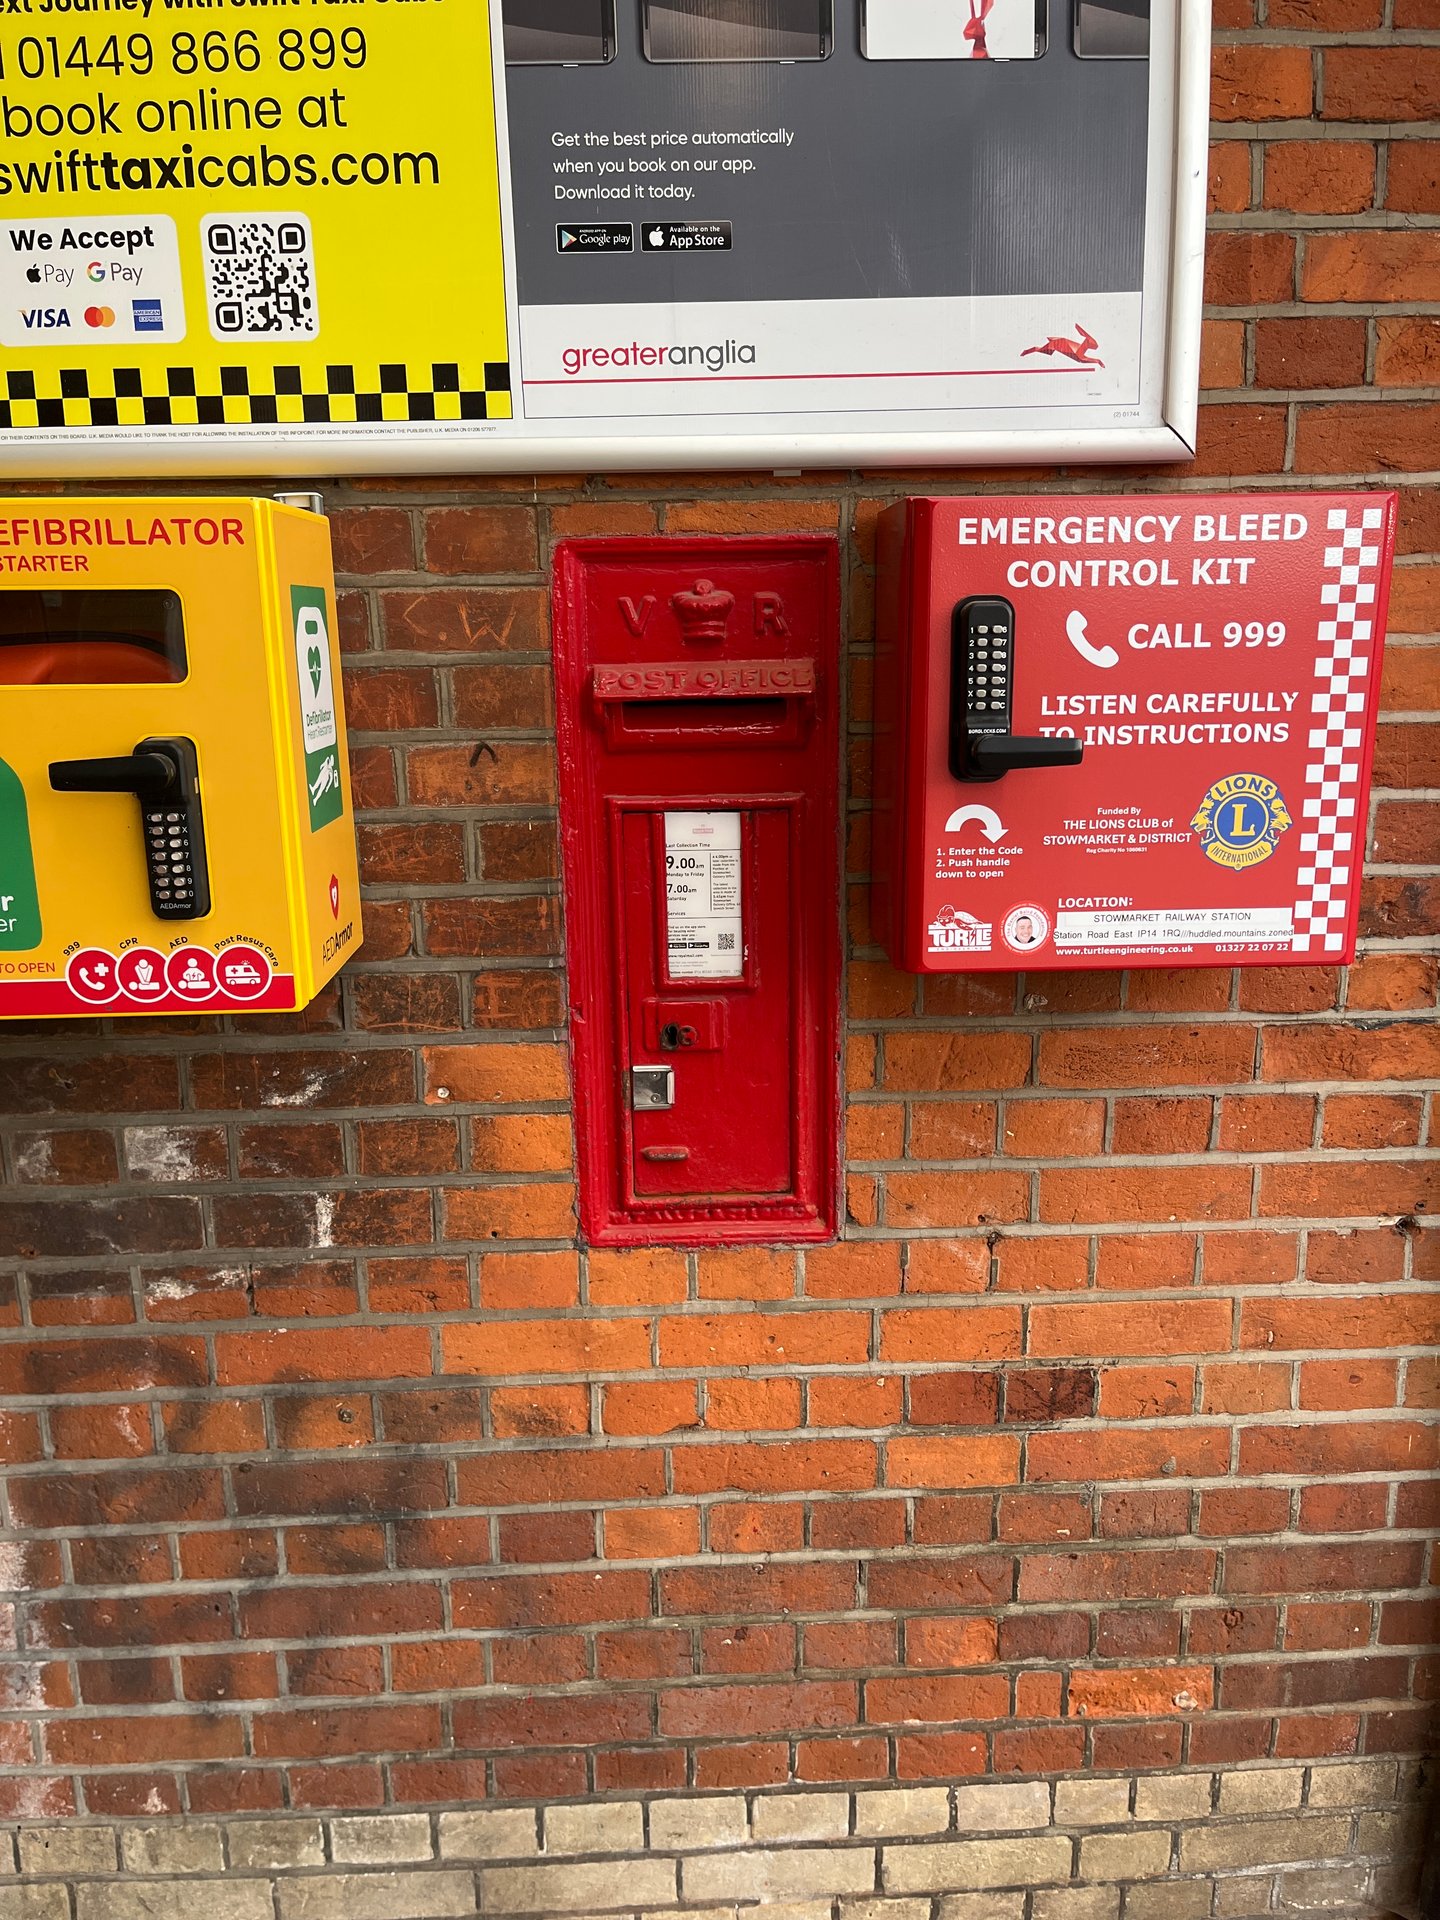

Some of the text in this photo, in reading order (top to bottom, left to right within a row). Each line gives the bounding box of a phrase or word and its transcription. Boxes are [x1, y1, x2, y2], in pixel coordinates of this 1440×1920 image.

[18, 33, 154, 78] 01449
[171, 30, 261, 75] 866
[278, 27, 367, 72] 899
[2, 88, 347, 137] book online at
[552, 128, 794, 149] Get the best price automatically
[553, 157, 756, 176] when you book on our app.
[554, 183, 695, 201] Download it today.
[9, 226, 155, 255] We Accept
[580, 233, 630, 247] Google play
[670, 235, 725, 248] App Store
[44, 264, 74, 287] Pay
[110, 263, 143, 286] Pay
[19, 309, 71, 328] VISA
[562, 340, 756, 375] greateranglia
[958, 513, 1308, 545] EMERGENCY BLEED
[1007, 557, 1256, 588] CONTROL KIT
[618, 591, 791, 637] V R
[1127, 621, 1286, 649] CALL 999
[597, 668, 813, 692] POST OFFICE
[1041, 691, 1299, 716] LISTEN CAREFULLY
[1083, 722, 1290, 746] INSTRUCTIONS
[1215, 777, 1273, 797] LIONS
[1097, 807, 1141, 816] Funded By
[1230, 804, 1255, 836] L
[1063, 818, 1173, 830] THE LIONS CLUB of
[1043, 833, 1192, 845] STOWMARKET & DISTRICT
[937, 846, 1023, 856] 1. Enter the Code
[1211, 845, 1268, 863] INTERNATIONAL
[936, 858, 1010, 867] 2. Push handle
[936, 870, 1004, 879] down to open
[1058, 897, 1133, 908] LOCATION:
[1094, 912, 1251, 922] STOWMARKET RAILWAY STATION
[1053, 931, 1082, 939] Station
[1087, 930, 1109, 938] Road
[1114, 930, 1133, 938] East
[1138, 929, 1157, 937] IP14
[63, 935, 279, 967] 999 CPR AED Post Resus Care
[1056, 945, 1193, 955] www.turtleengineering.co.uk
[1215, 944, 1245, 952] 01327
[1277, 943, 1288, 951] 22
[18, 962, 55, 973] OPEN
